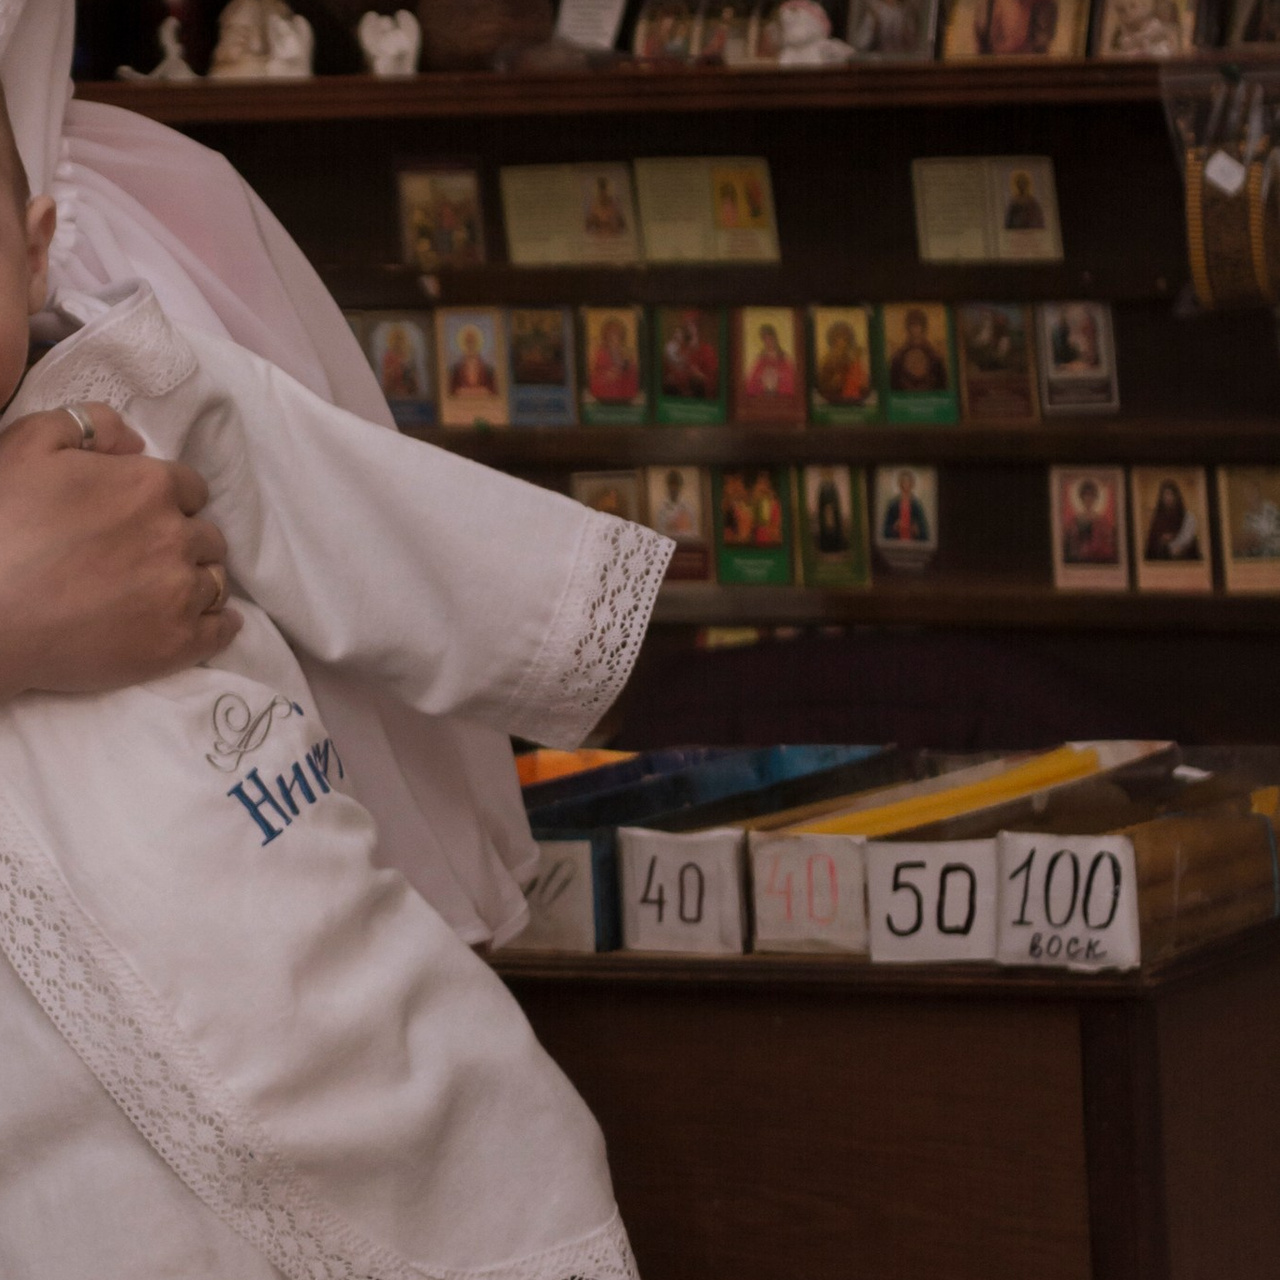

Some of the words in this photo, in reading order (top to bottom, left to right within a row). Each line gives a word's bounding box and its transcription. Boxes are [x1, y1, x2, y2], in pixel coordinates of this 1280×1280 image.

[640, 855, 705, 924] 40
[764, 853, 839, 925] 40
[886, 860, 977, 937] 50
[1008, 847, 1122, 930] 100
